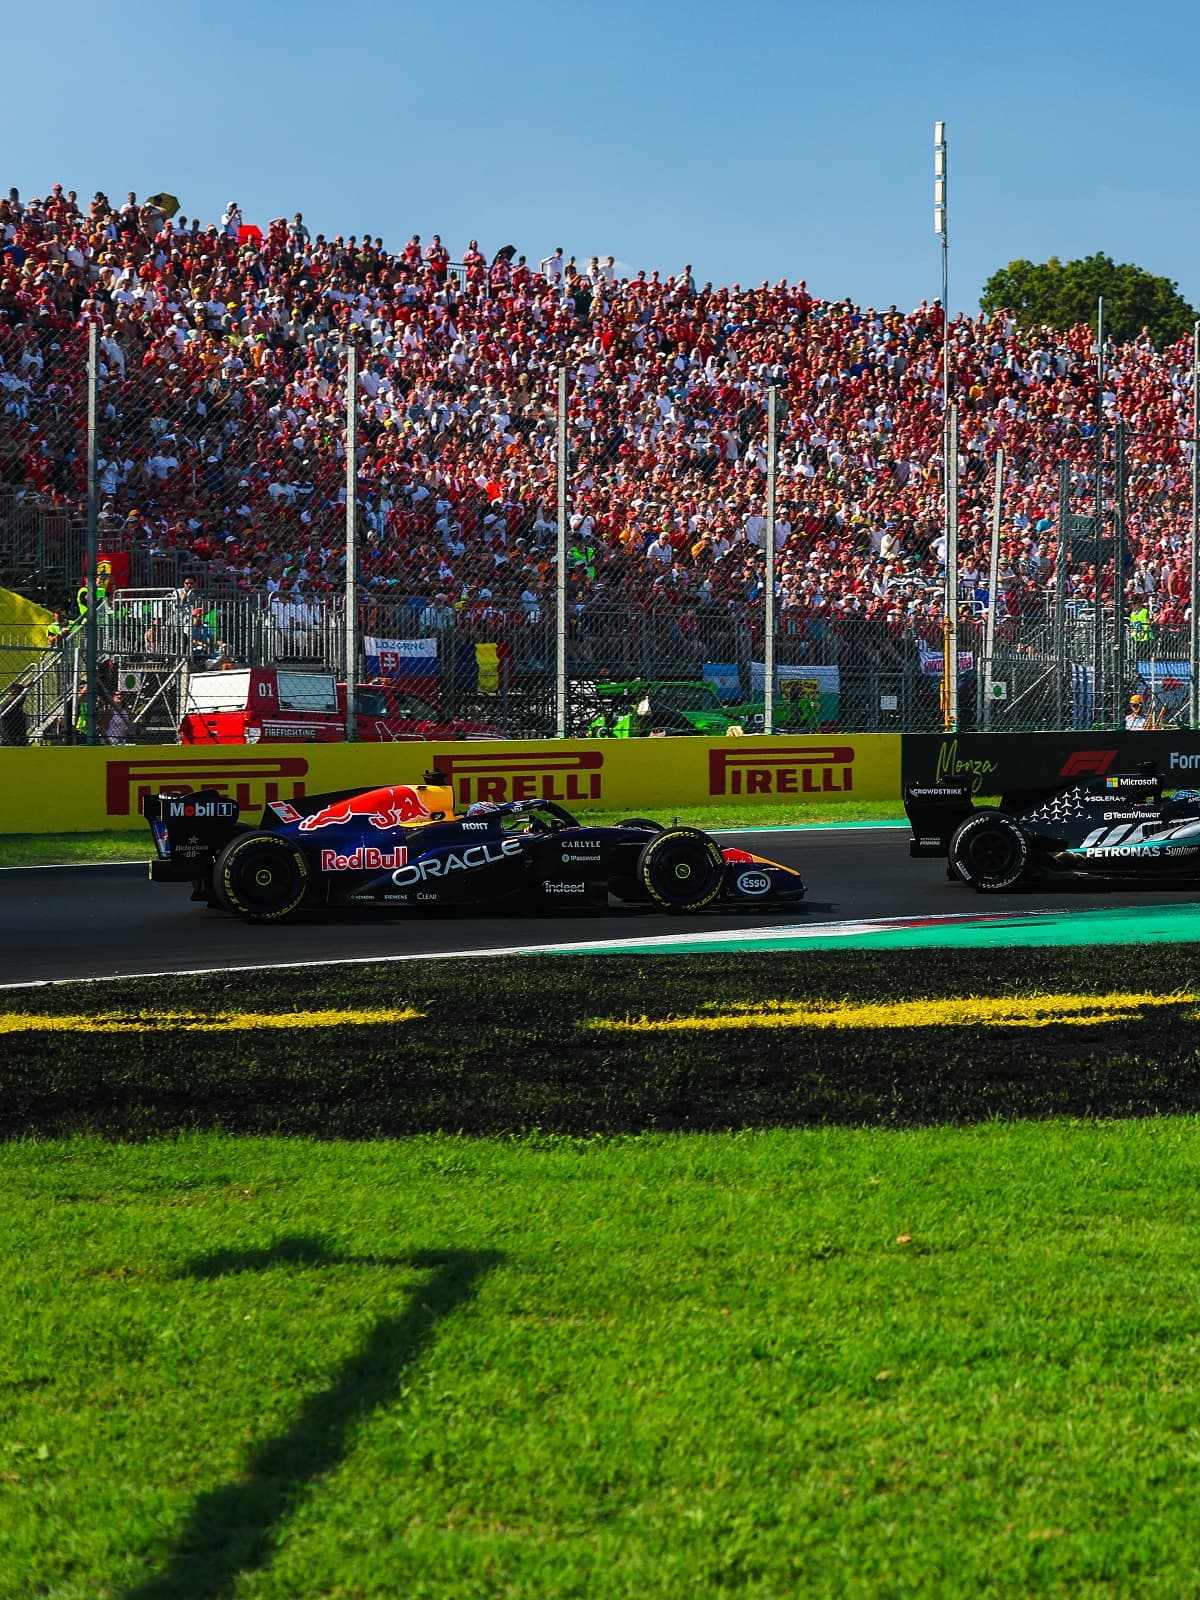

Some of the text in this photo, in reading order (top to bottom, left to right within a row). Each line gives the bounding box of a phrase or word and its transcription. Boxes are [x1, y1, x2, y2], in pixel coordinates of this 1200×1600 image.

[259, 682, 273, 697] 01
[265, 728, 316, 737] FIREFIGHTING
[709, 747, 854, 795] PIRELLI
[936, 738, 998, 793] Monza
[433, 752, 604, 804] PIRELLI
[1120, 778, 1158, 787] Microsoft
[170, 802, 214, 817] Mobil
[321, 845, 408, 871] Red Bull
[1086, 847, 1161, 858] PETRONAS
[392, 838, 523, 886] ORACLE
[543, 880, 585, 893] indeed
